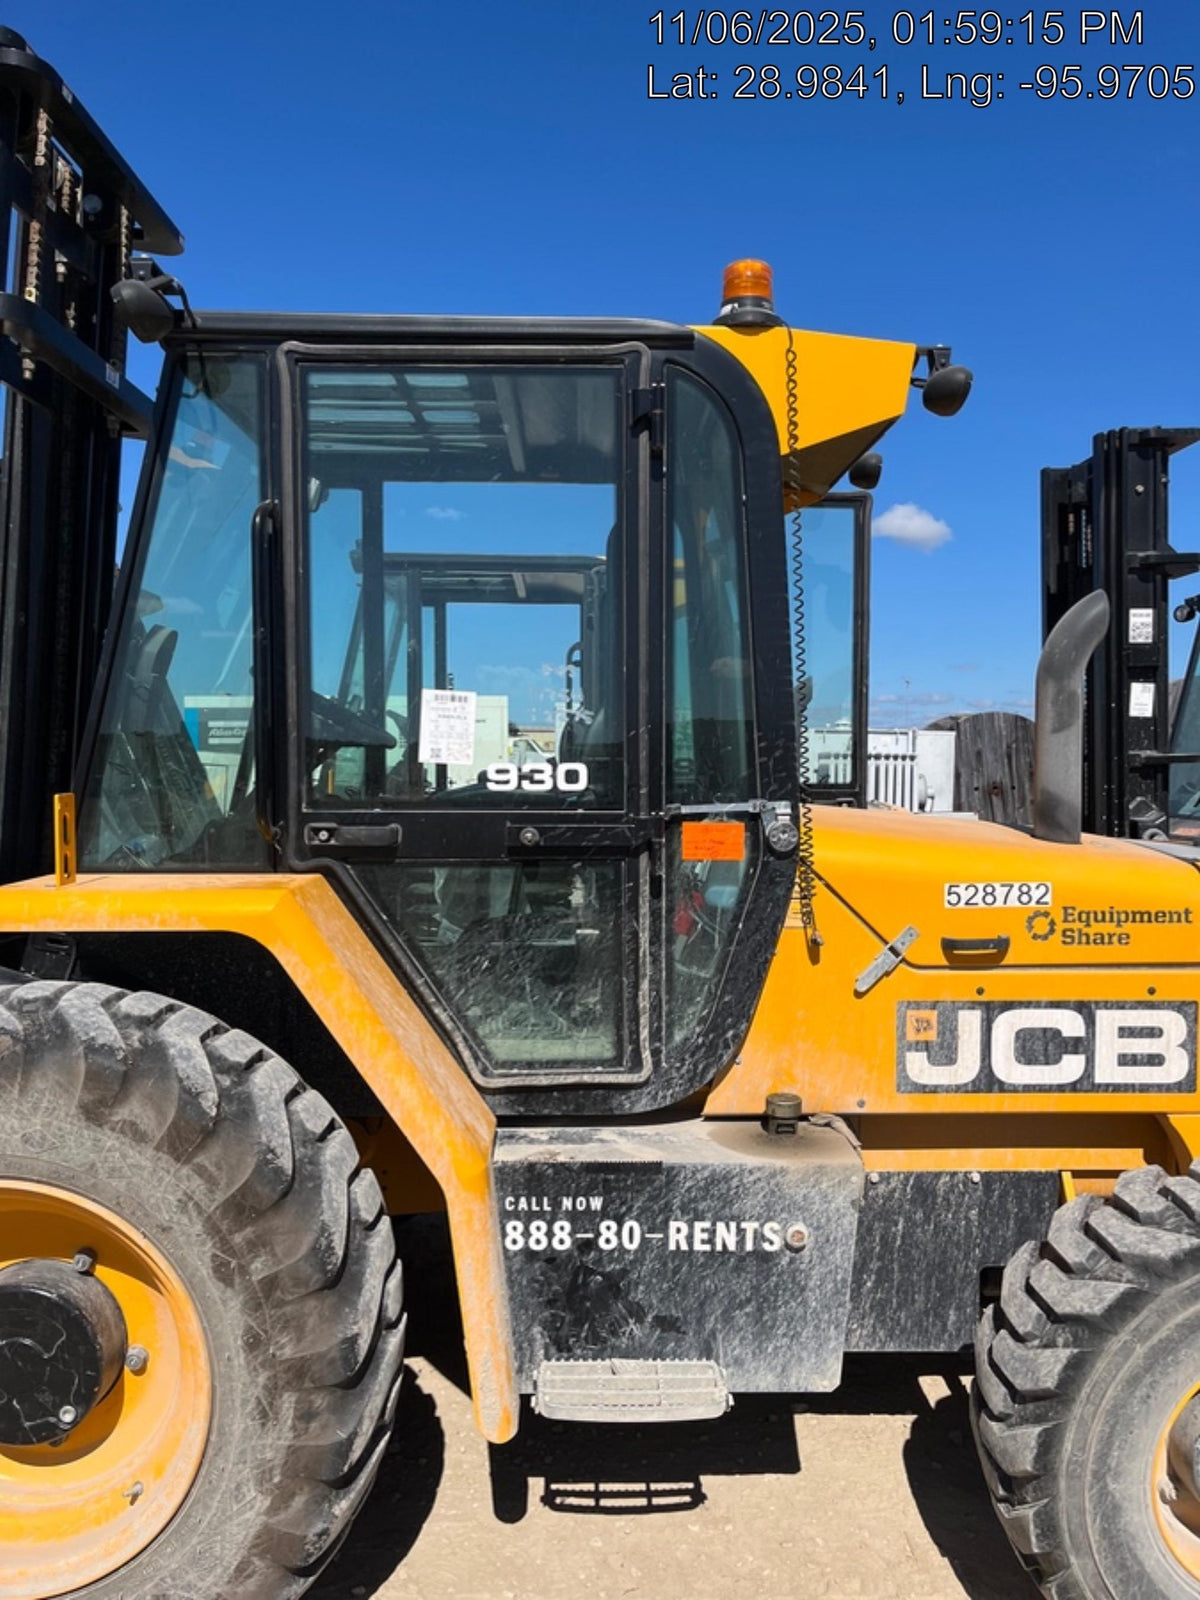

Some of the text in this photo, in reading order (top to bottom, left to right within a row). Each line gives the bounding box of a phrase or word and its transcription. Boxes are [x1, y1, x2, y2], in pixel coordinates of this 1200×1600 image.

[486, 762, 588, 792] 930
[946, 882, 1050, 907] 528782
[1061, 906, 1193, 925] Equipment
[1061, 927, 1131, 946] Share
[905, 1008, 1190, 1086] JCB
[504, 1196, 605, 1212] CALL NOW
[504, 1220, 783, 1252] 888-80-RENTS
